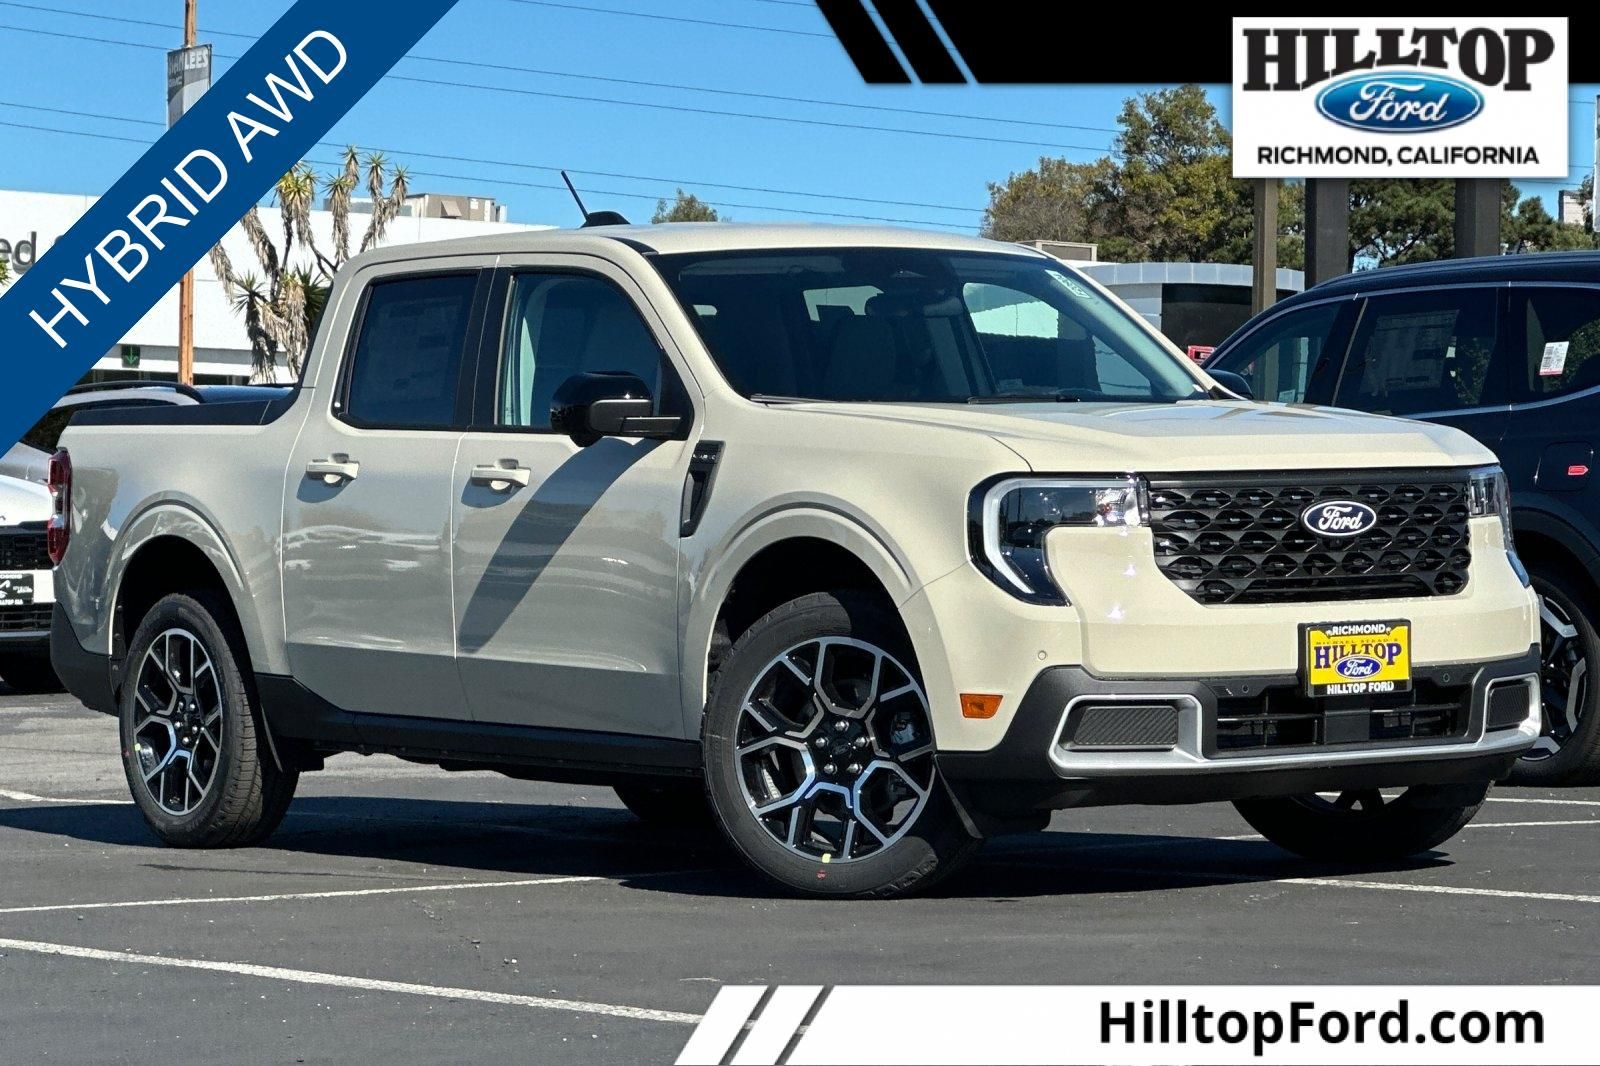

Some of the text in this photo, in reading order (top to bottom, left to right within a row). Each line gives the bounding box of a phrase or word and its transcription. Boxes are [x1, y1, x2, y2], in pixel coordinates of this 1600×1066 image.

[1318, 505, 1364, 531] Ford
[1331, 623, 1386, 636] RICHMOND
[1314, 642, 1402, 670] HILLTOP
[1344, 660, 1373, 676] Ford
[1326, 680, 1395, 695] HILLTOP FORD
